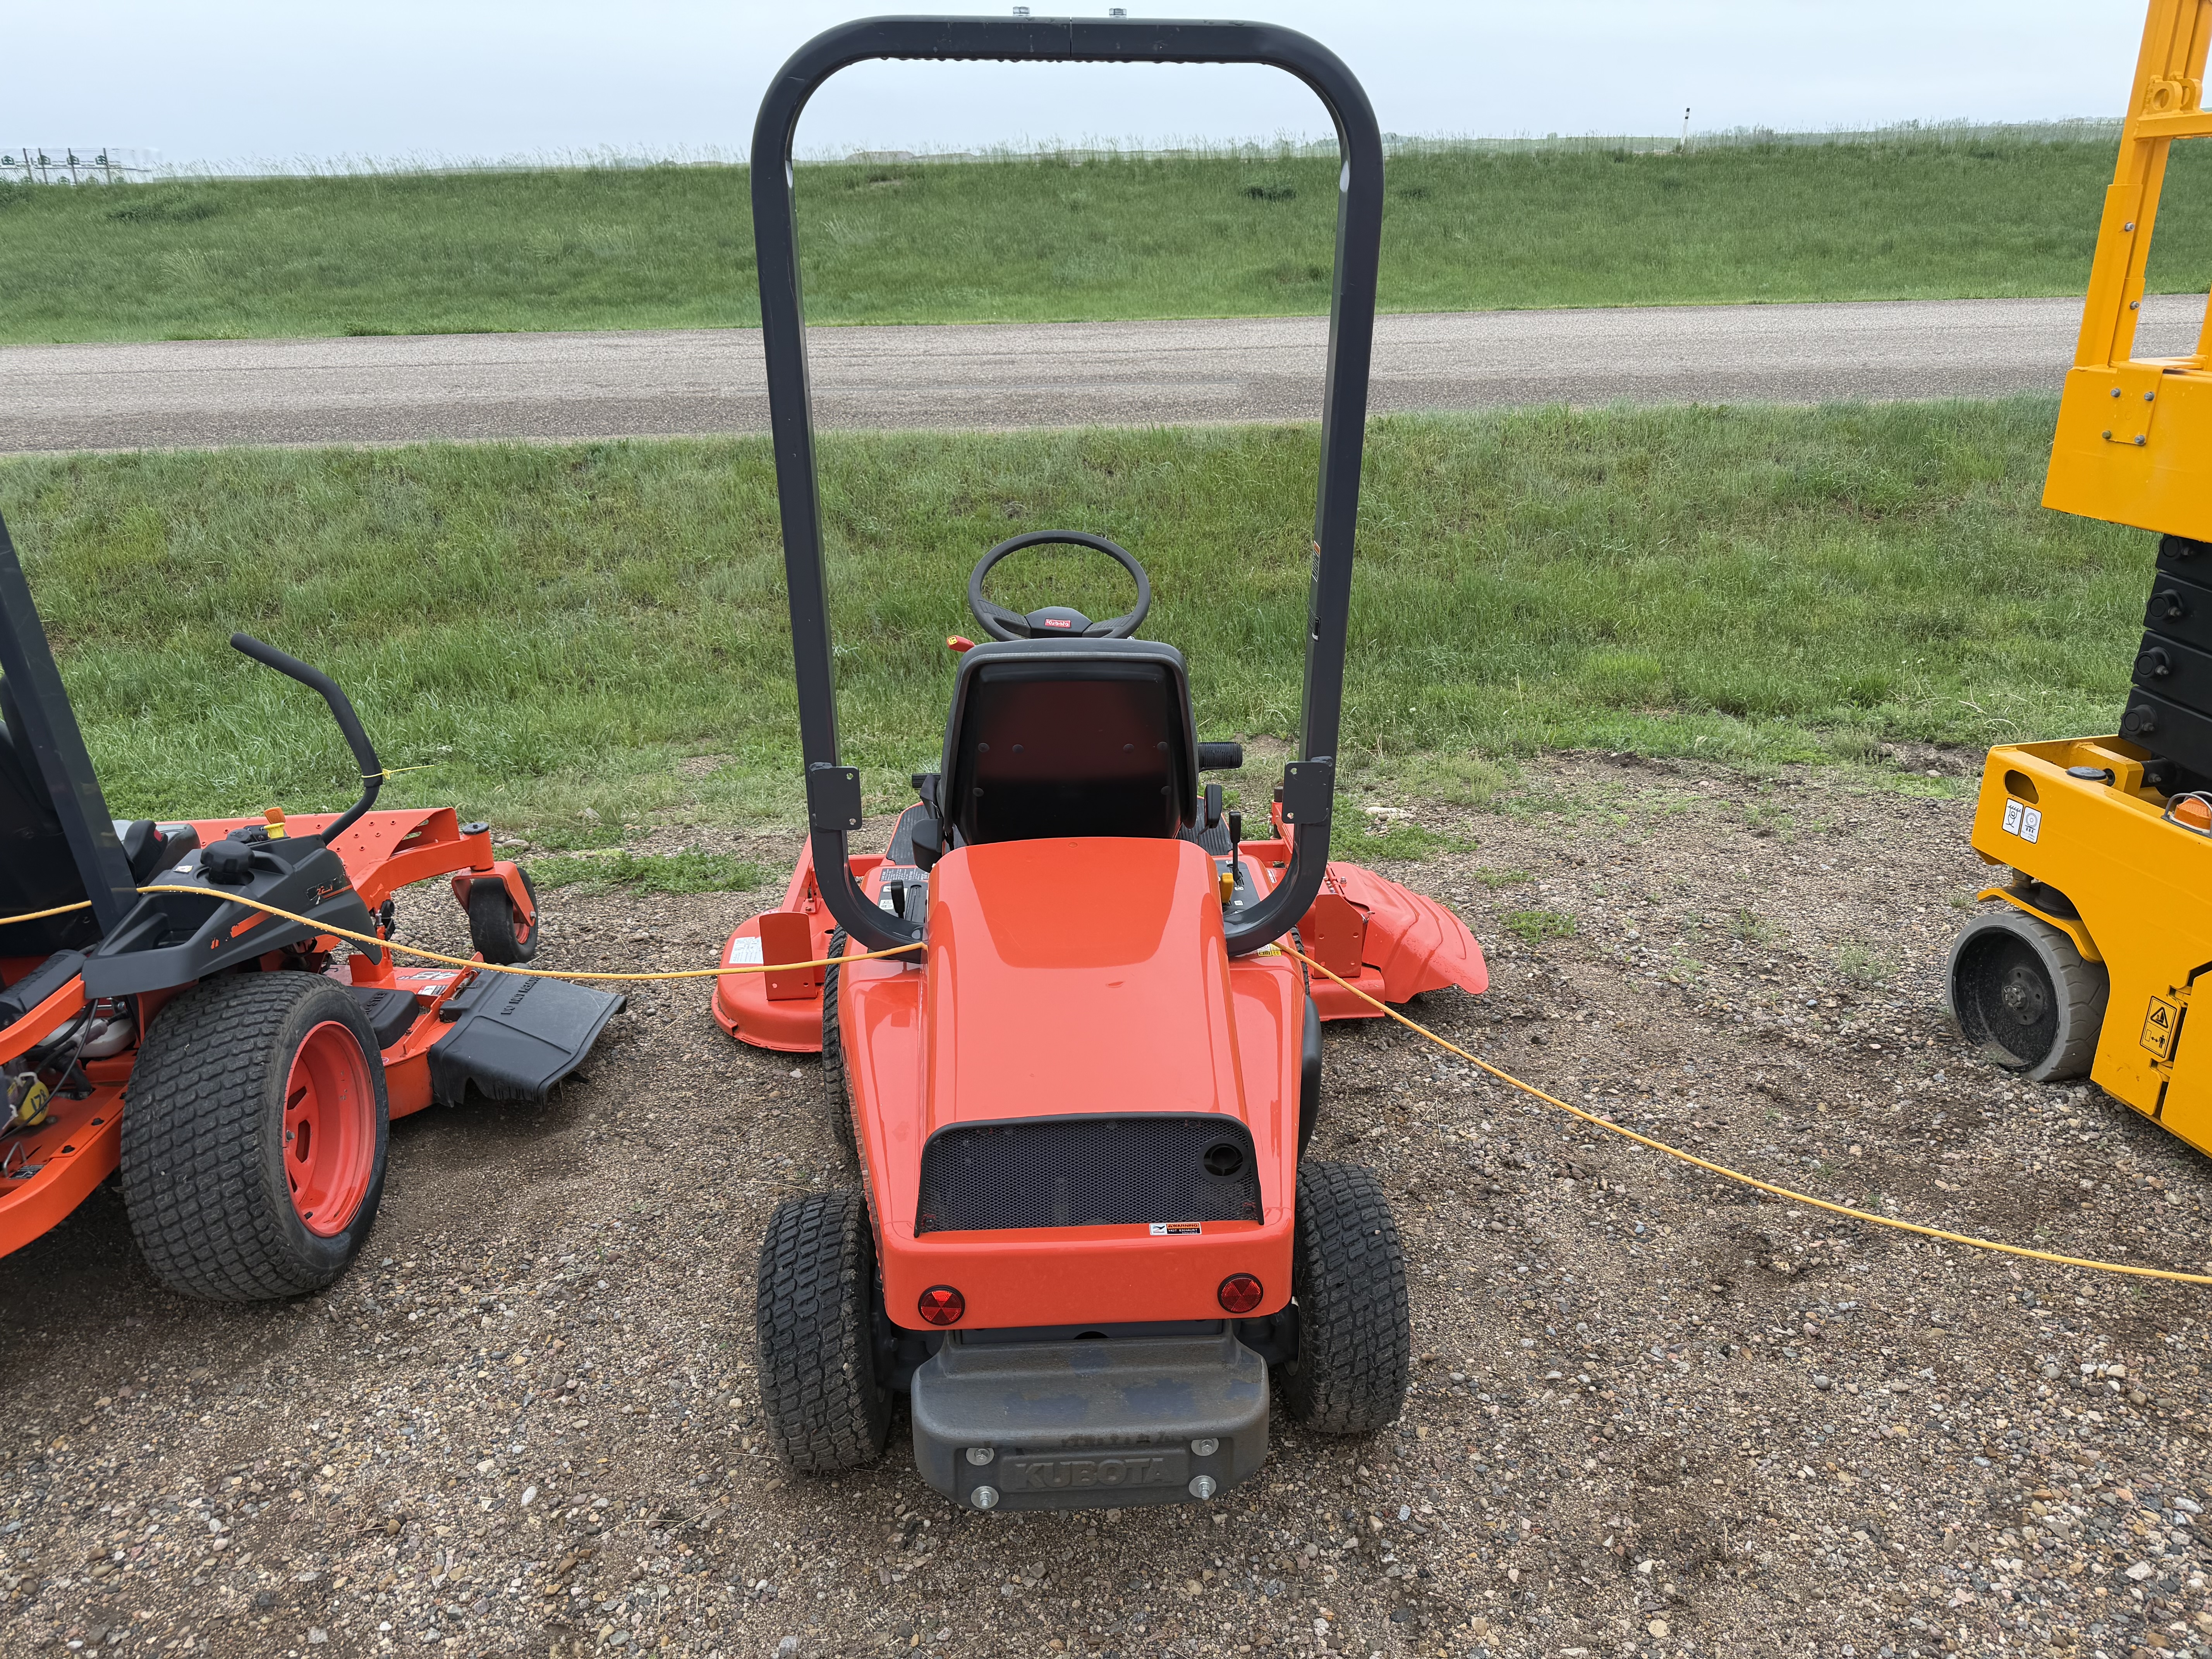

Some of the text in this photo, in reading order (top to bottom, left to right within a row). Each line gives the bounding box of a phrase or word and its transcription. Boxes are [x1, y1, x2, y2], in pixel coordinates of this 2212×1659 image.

[501, 1006, 515, 1014] DO
[509, 993, 525, 1004] NOT
[1015, 1458, 1174, 1489] KUBOTA
